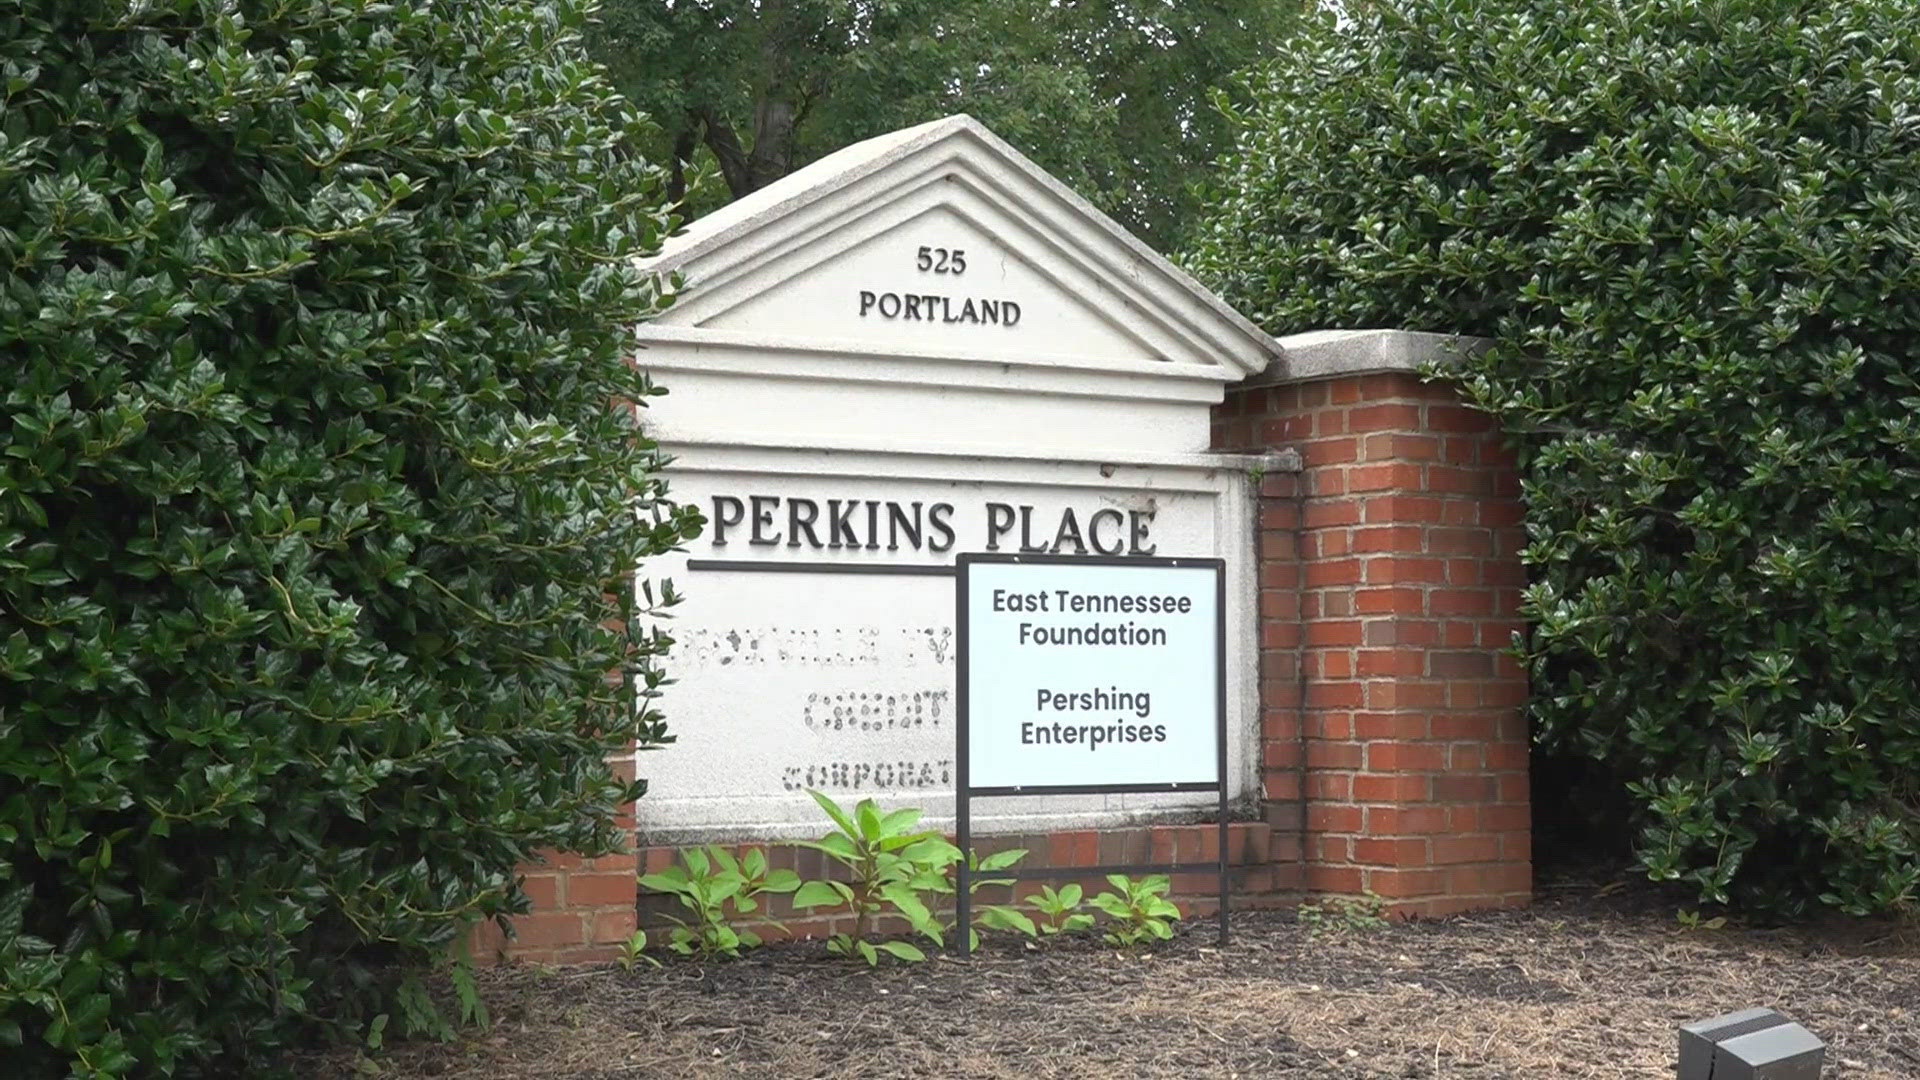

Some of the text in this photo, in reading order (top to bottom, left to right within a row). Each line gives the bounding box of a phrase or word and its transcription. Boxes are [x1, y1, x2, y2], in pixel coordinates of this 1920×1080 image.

[917, 246, 967, 275] 525
[859, 290, 1022, 327] PORTLAND
[711, 495, 1157, 556] PERKINS PLACE
[993, 589, 1192, 614] East Tennessee
[1019, 621, 1166, 646] Foundation
[1037, 686, 1150, 718] Pershing
[1021, 718, 1167, 751] Enterprises
